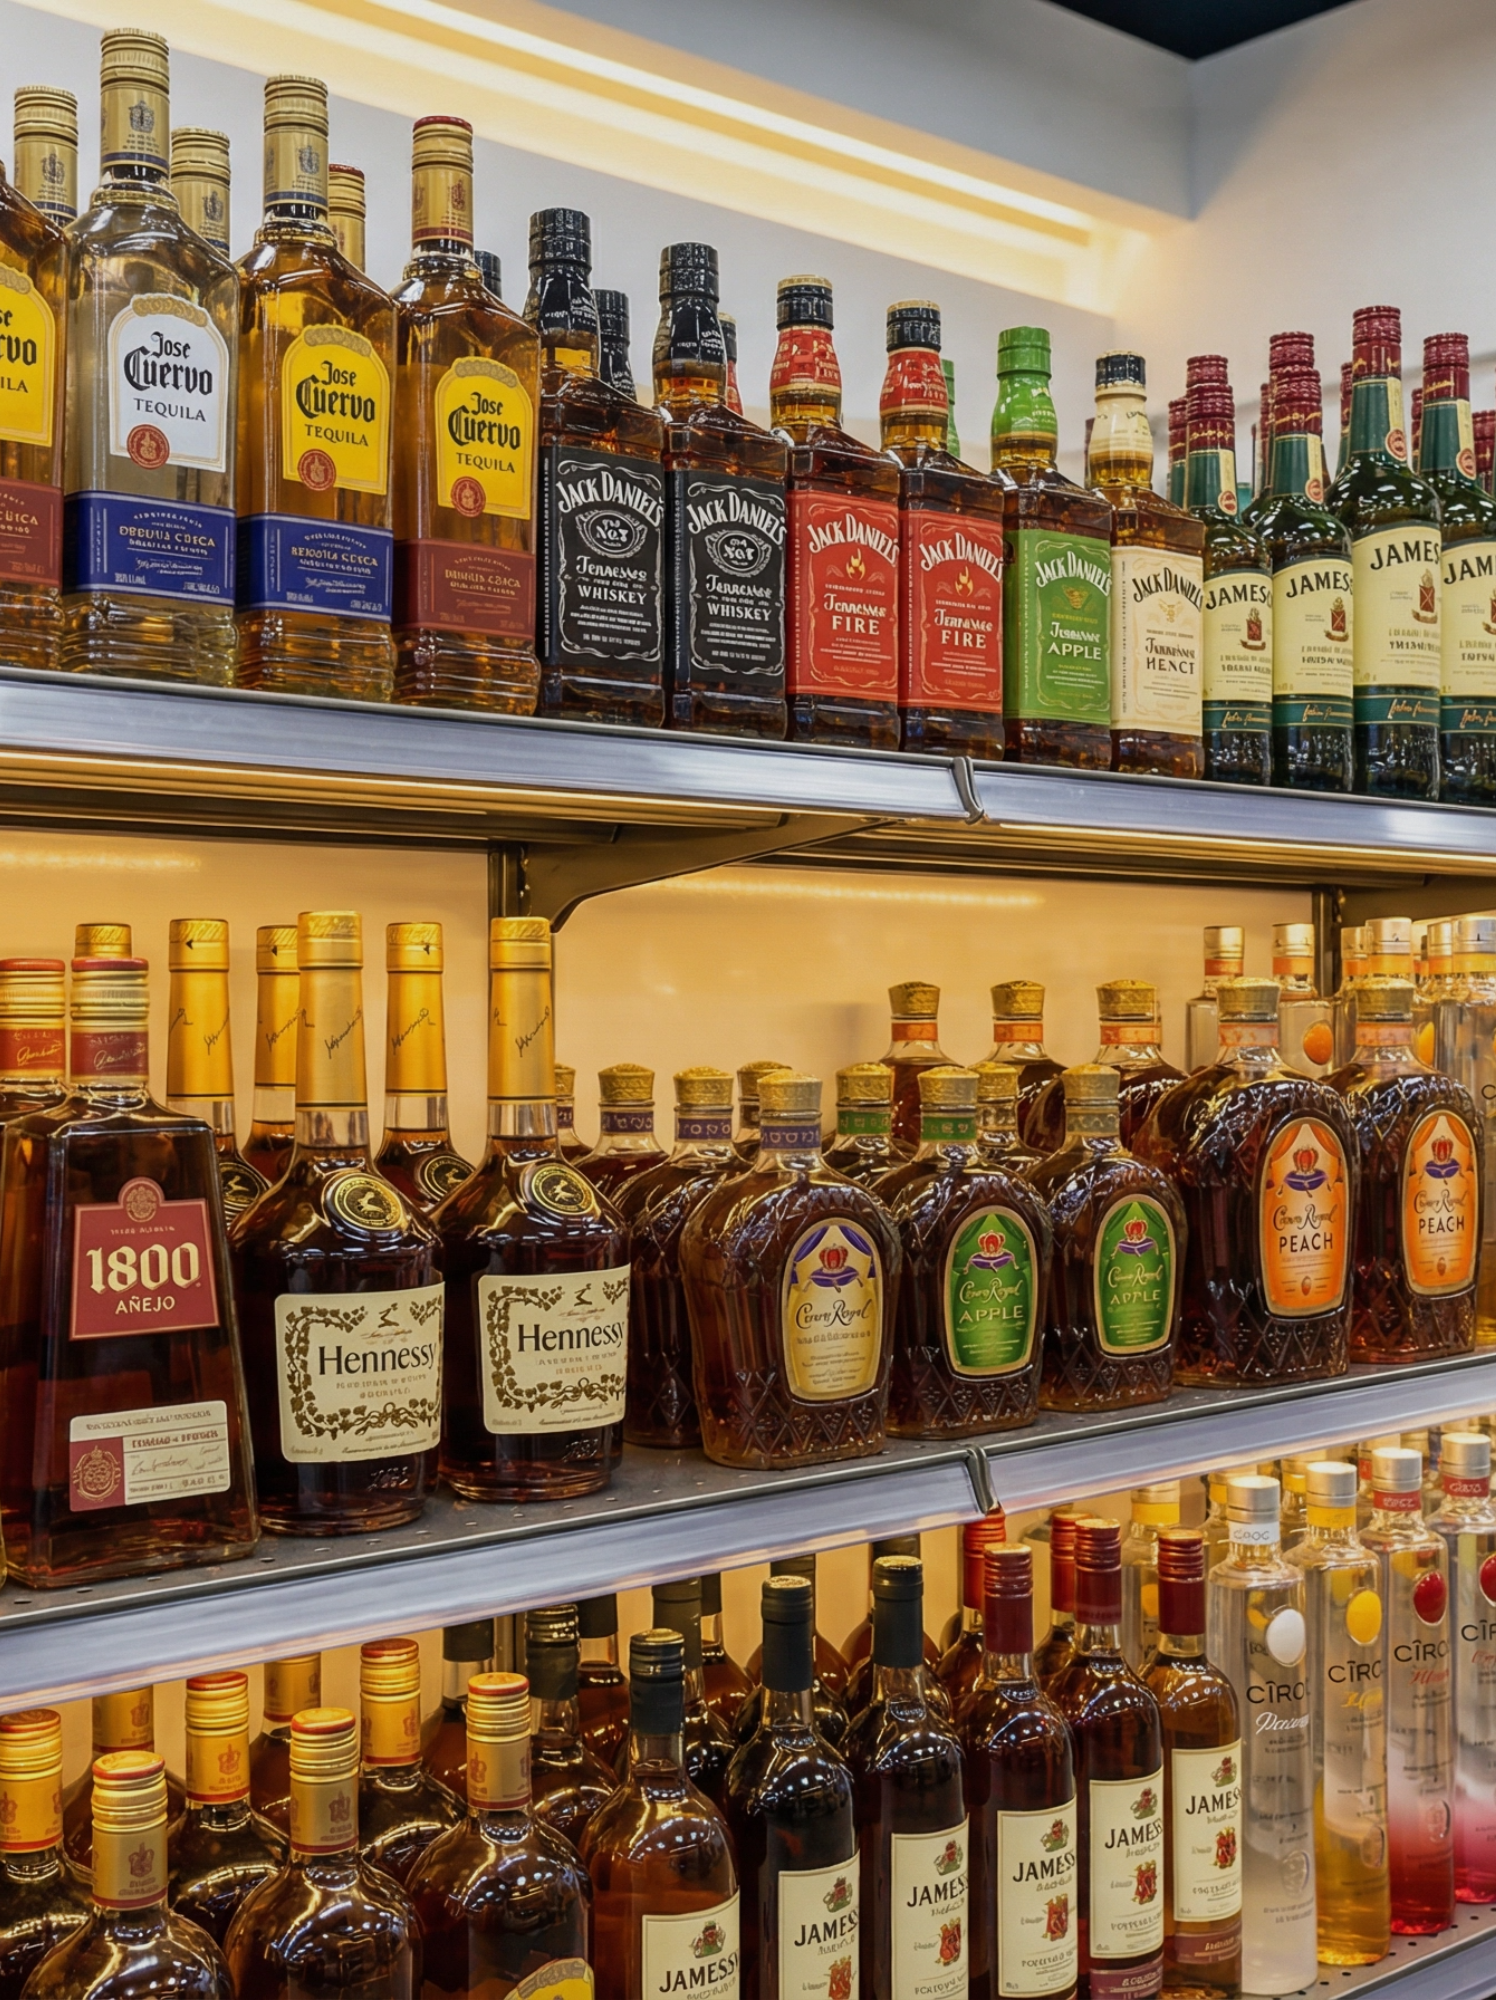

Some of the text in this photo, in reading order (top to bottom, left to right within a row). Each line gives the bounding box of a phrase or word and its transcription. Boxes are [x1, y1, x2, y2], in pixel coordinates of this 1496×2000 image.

[151, 331, 191, 359] Jose
[124, 345, 213, 396] Cuervo
[321, 360, 357, 387] Jose
[133, 398, 206, 422] TEQUILA
[295, 374, 376, 423] Cuervo
[470, 391, 504, 416] Jose
[304, 424, 369, 447] TEQUILA
[448, 405, 521, 450] Cuervo
[455, 452, 516, 473] TEQUILA
[556, 478, 601, 513] JACK
[686, 499, 728, 534] JACK
[807, 521, 845, 553] JACK
[919, 539, 955, 571] JACK
[1035, 557, 1067, 588] JACK
[1443, 555, 1496, 585] JAM
[577, 584, 647, 605] WHISKEY
[1132, 572, 1163, 603] JACK
[1286, 571, 1353, 598] JAMES
[707, 602, 772, 621] WHISKEY
[832, 615, 880, 635] FIRE
[941, 630, 986, 649] FIRE
[1047, 642, 1102, 660] APPLE
[1419, 1216, 1465, 1235] PEACH
[1279, 1232, 1333, 1254] PEACH
[86, 1242, 200, 1294] 1800
[115, 1295, 176, 1315] AÑEJO
[959, 1305, 1024, 1324] APPLE
[518, 1321, 625, 1352] Hennessy
[318, 1342, 437, 1375] Hennessy
